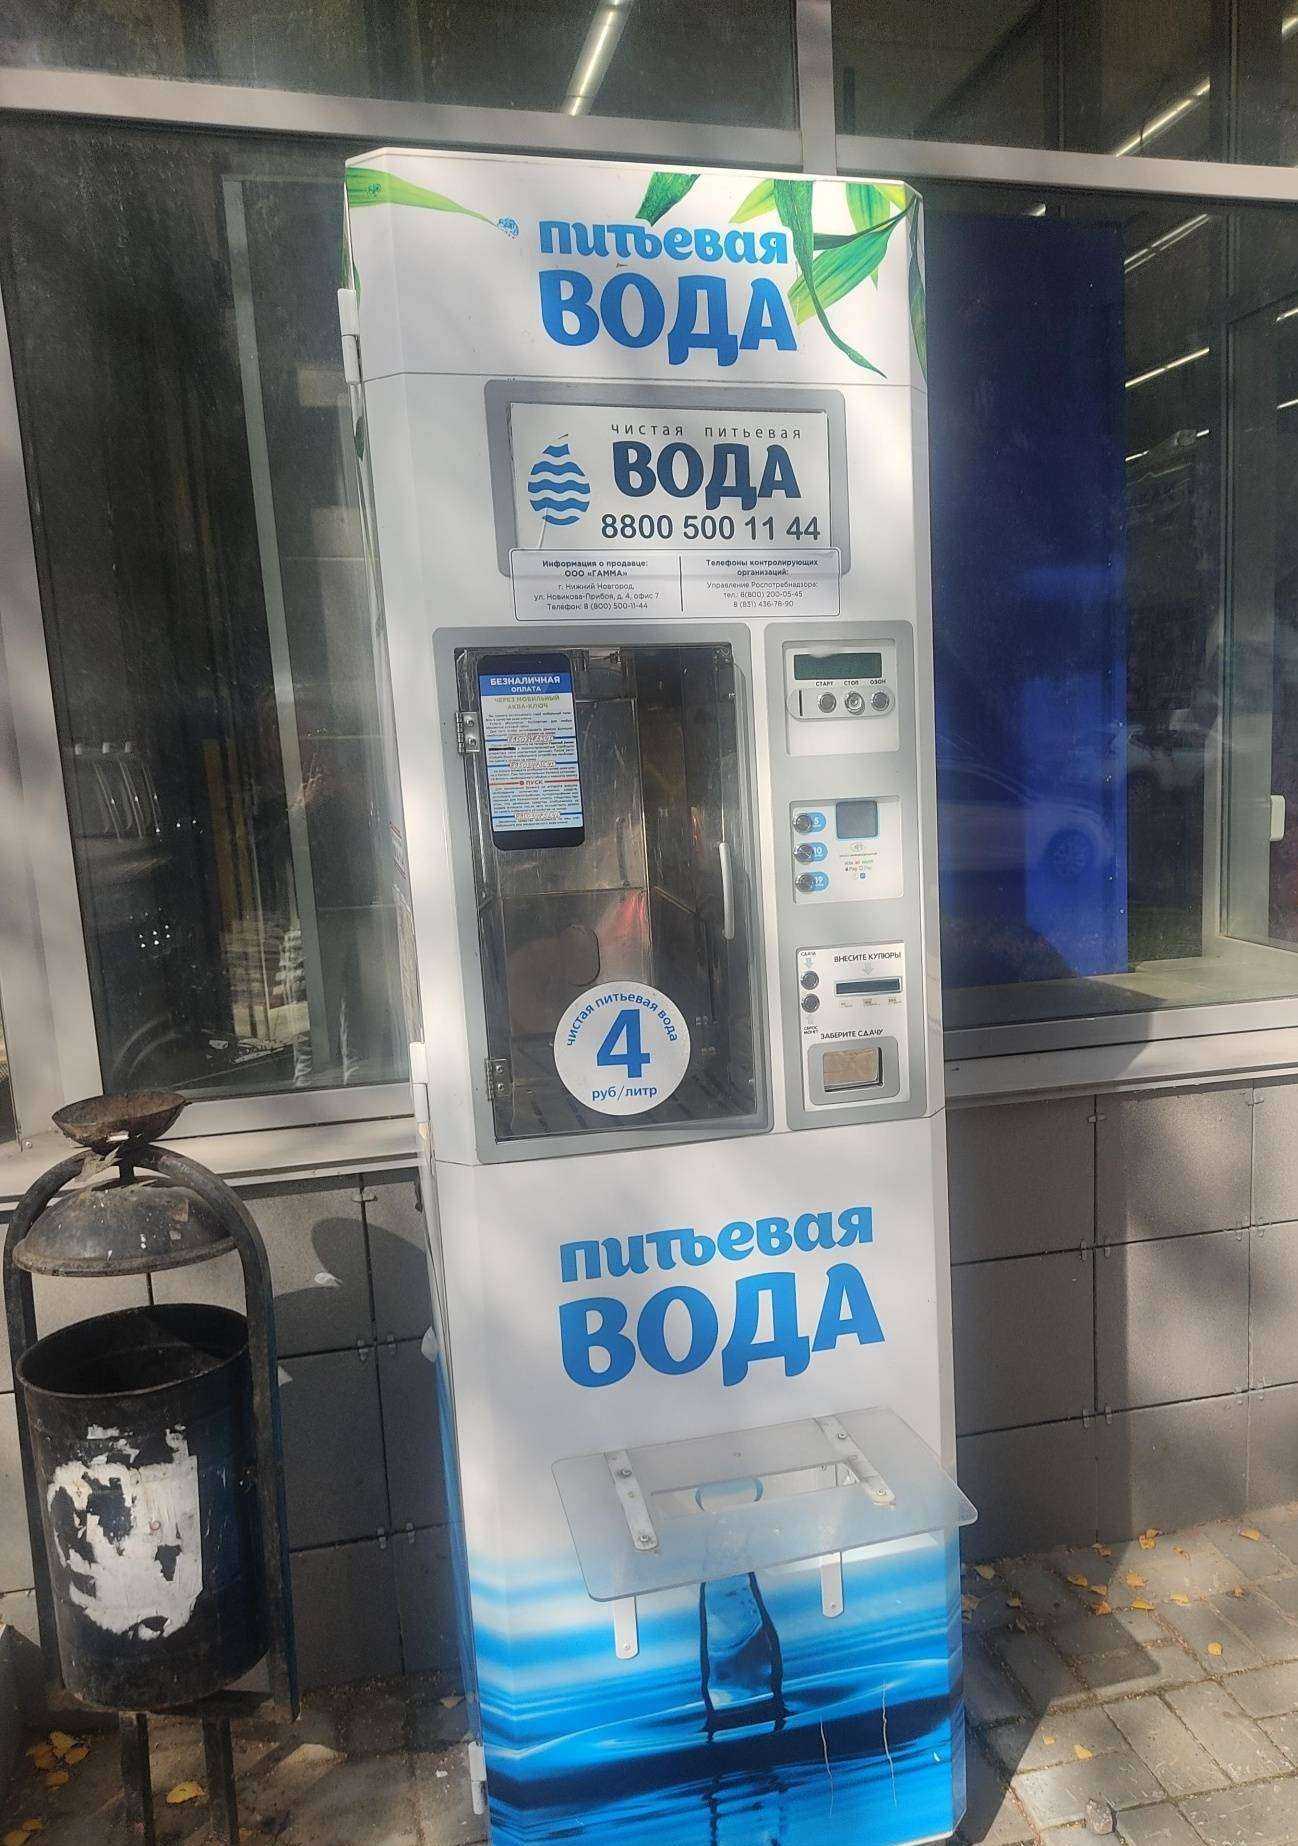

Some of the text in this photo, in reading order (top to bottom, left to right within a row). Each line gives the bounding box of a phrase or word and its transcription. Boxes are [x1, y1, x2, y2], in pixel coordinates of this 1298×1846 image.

[538, 220, 788, 264] питьевая
[538, 269, 798, 367] ВОДА
[611, 423, 801, 439] чистая питьевая
[612, 440, 801, 511] ВОДА
[601, 513, 821, 541] 8800 500 11 44
[542, 560, 597, 569] Информация
[606, 560, 649, 569] продавце:
[706, 559, 819, 568] Телефоны контролирующих
[737, 568, 789, 577] организаций:
[706, 582, 750, 590] Управление
[633, 592, 654, 601] офис
[590, 603, 612, 611] (800)
[490, 676, 561, 686] БЕЗНАЛИЧНАЯ
[833, 952, 902, 963] ВНЕСИТЕ КУПЮРЫ
[566, 993, 679, 1046] чистая питьевая вода
[820, 1028, 884, 1040] ЗАБЕРИТЕ СДАЧУ
[596, 1008, 651, 1079] 4
[559, 1206, 873, 1283] питьевая
[558, 1262, 885, 1388] ВОДА
